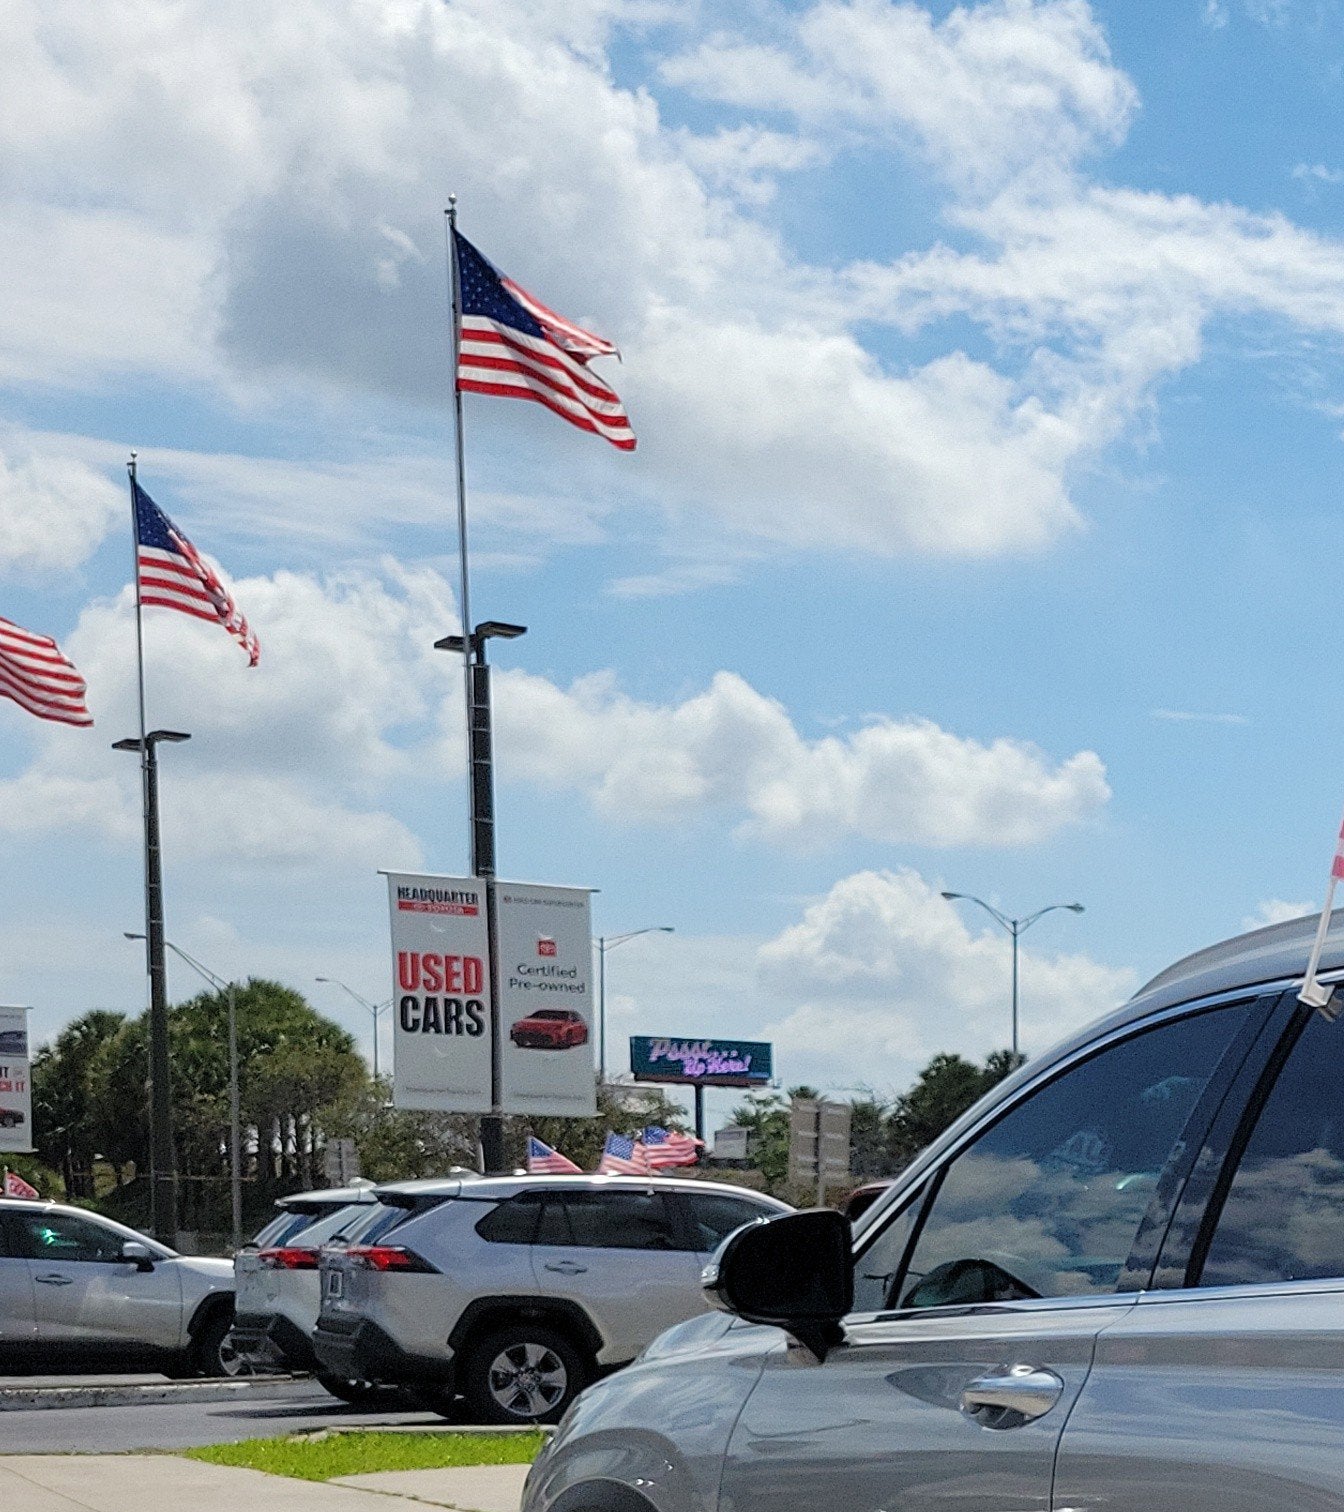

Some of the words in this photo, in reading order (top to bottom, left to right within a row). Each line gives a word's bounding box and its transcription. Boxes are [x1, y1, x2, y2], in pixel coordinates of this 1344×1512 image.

[397, 886, 479, 906] HEADQUARTER
[397, 951, 484, 995] USED
[517, 963, 577, 978] Certified
[509, 978, 586, 993] Pre-owned
[399, 995, 485, 1037] CARS
